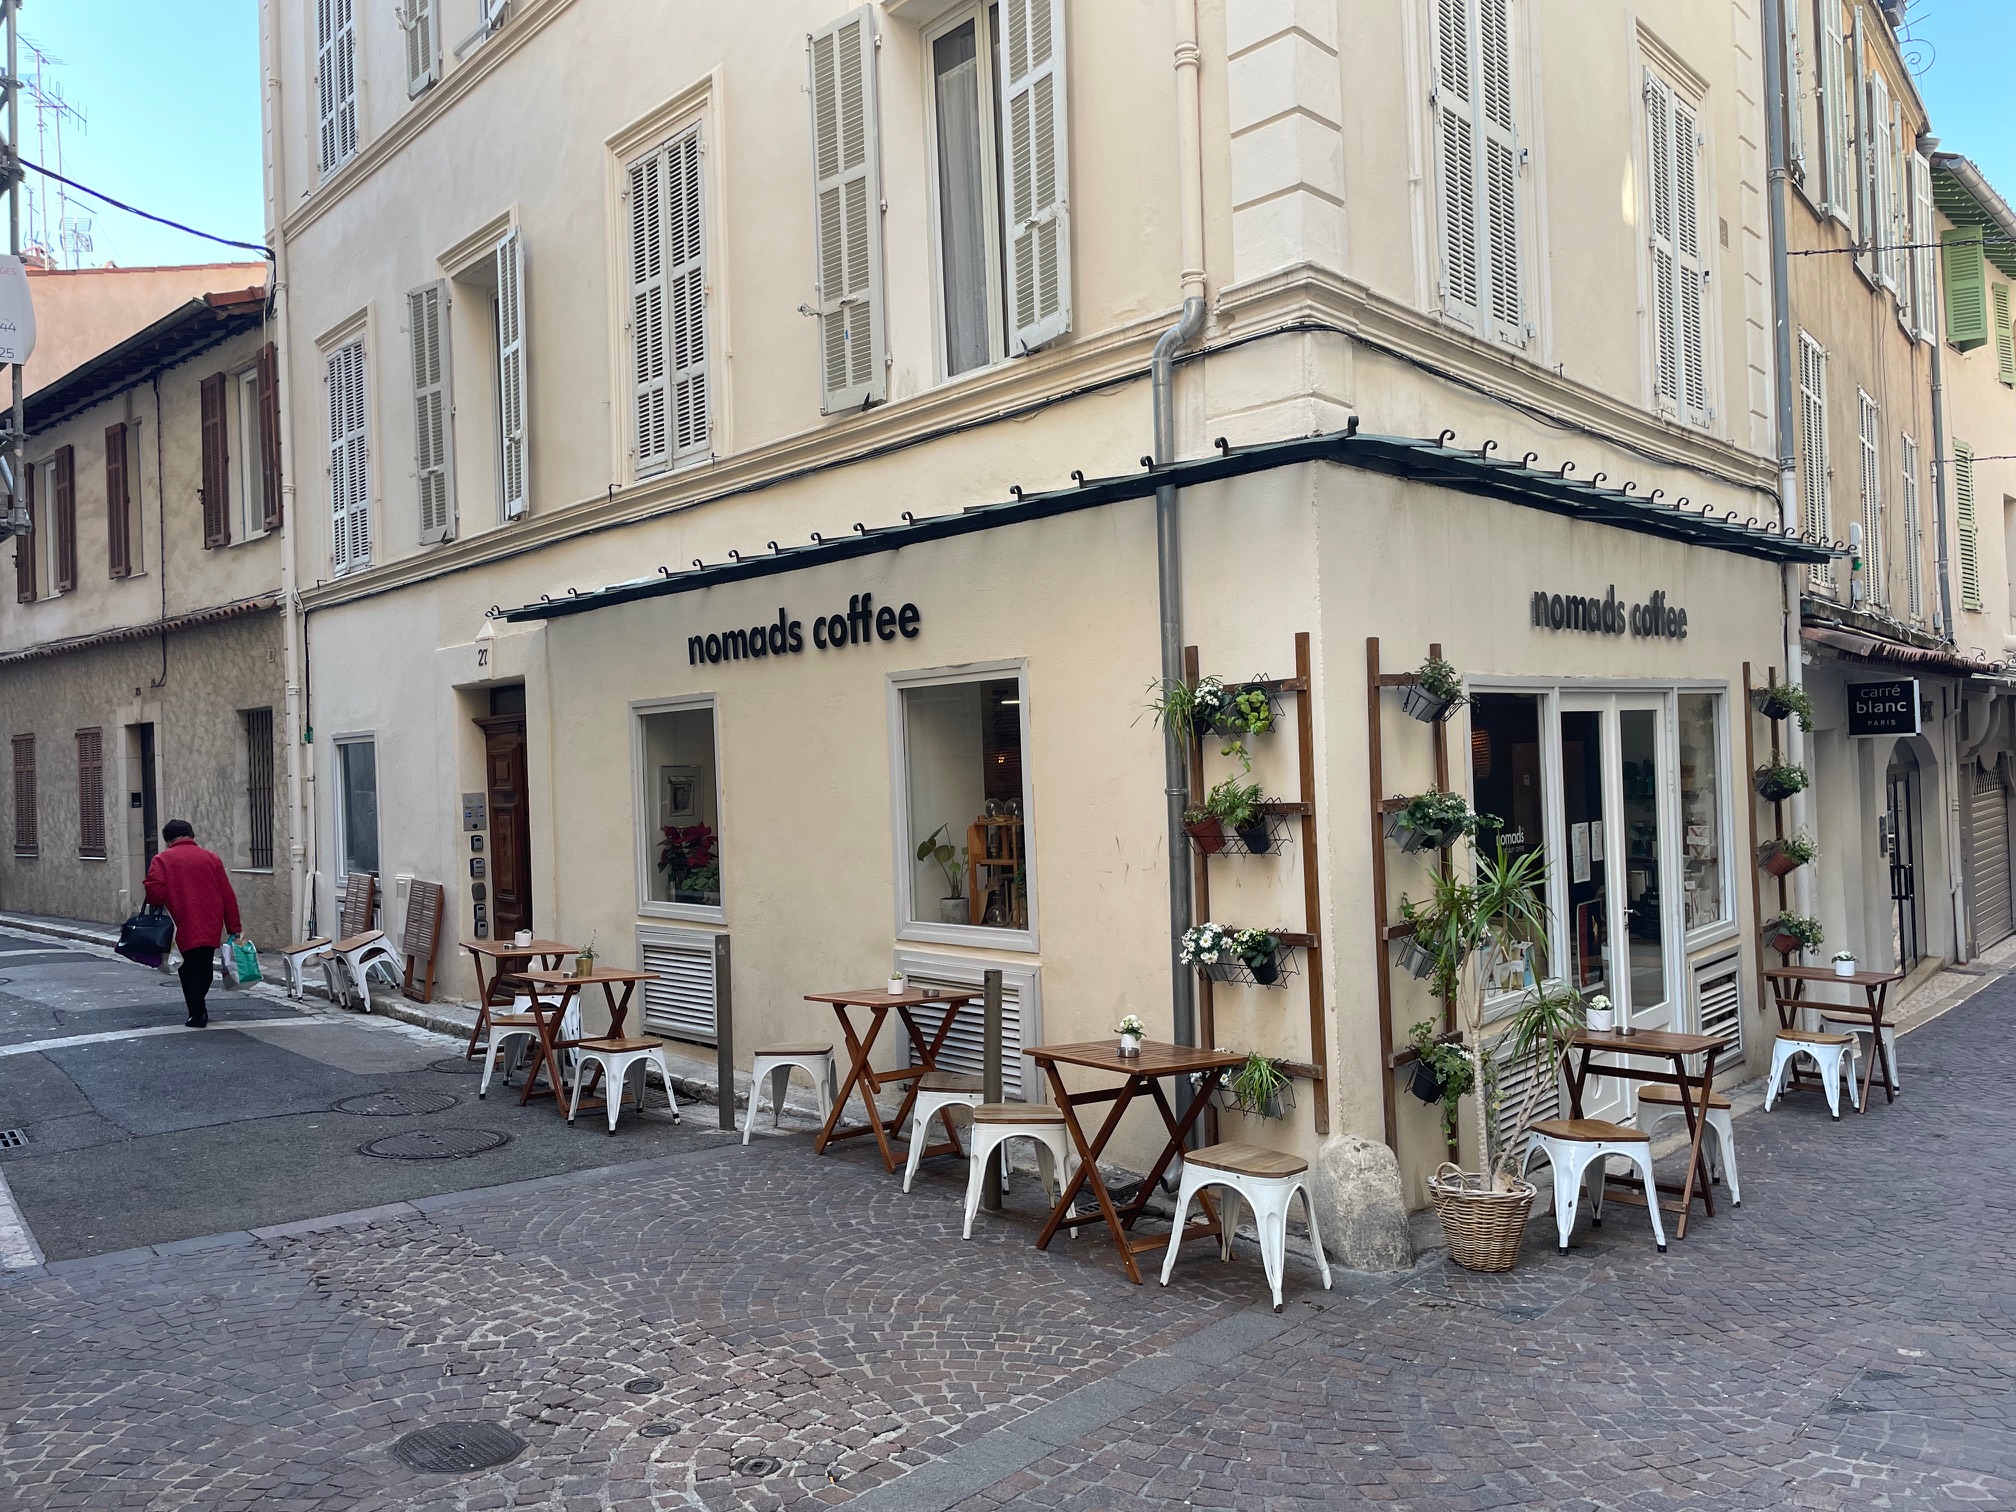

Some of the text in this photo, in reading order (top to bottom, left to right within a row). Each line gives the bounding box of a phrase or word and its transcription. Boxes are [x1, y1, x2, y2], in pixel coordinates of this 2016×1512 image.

[1532, 584, 1688, 638] nomads coffee
[688, 592, 921, 665] nomads coffee
[478, 648, 488, 666] 27
[1861, 684, 1901, 698] carré
[1856, 701, 1907, 714] blanc
